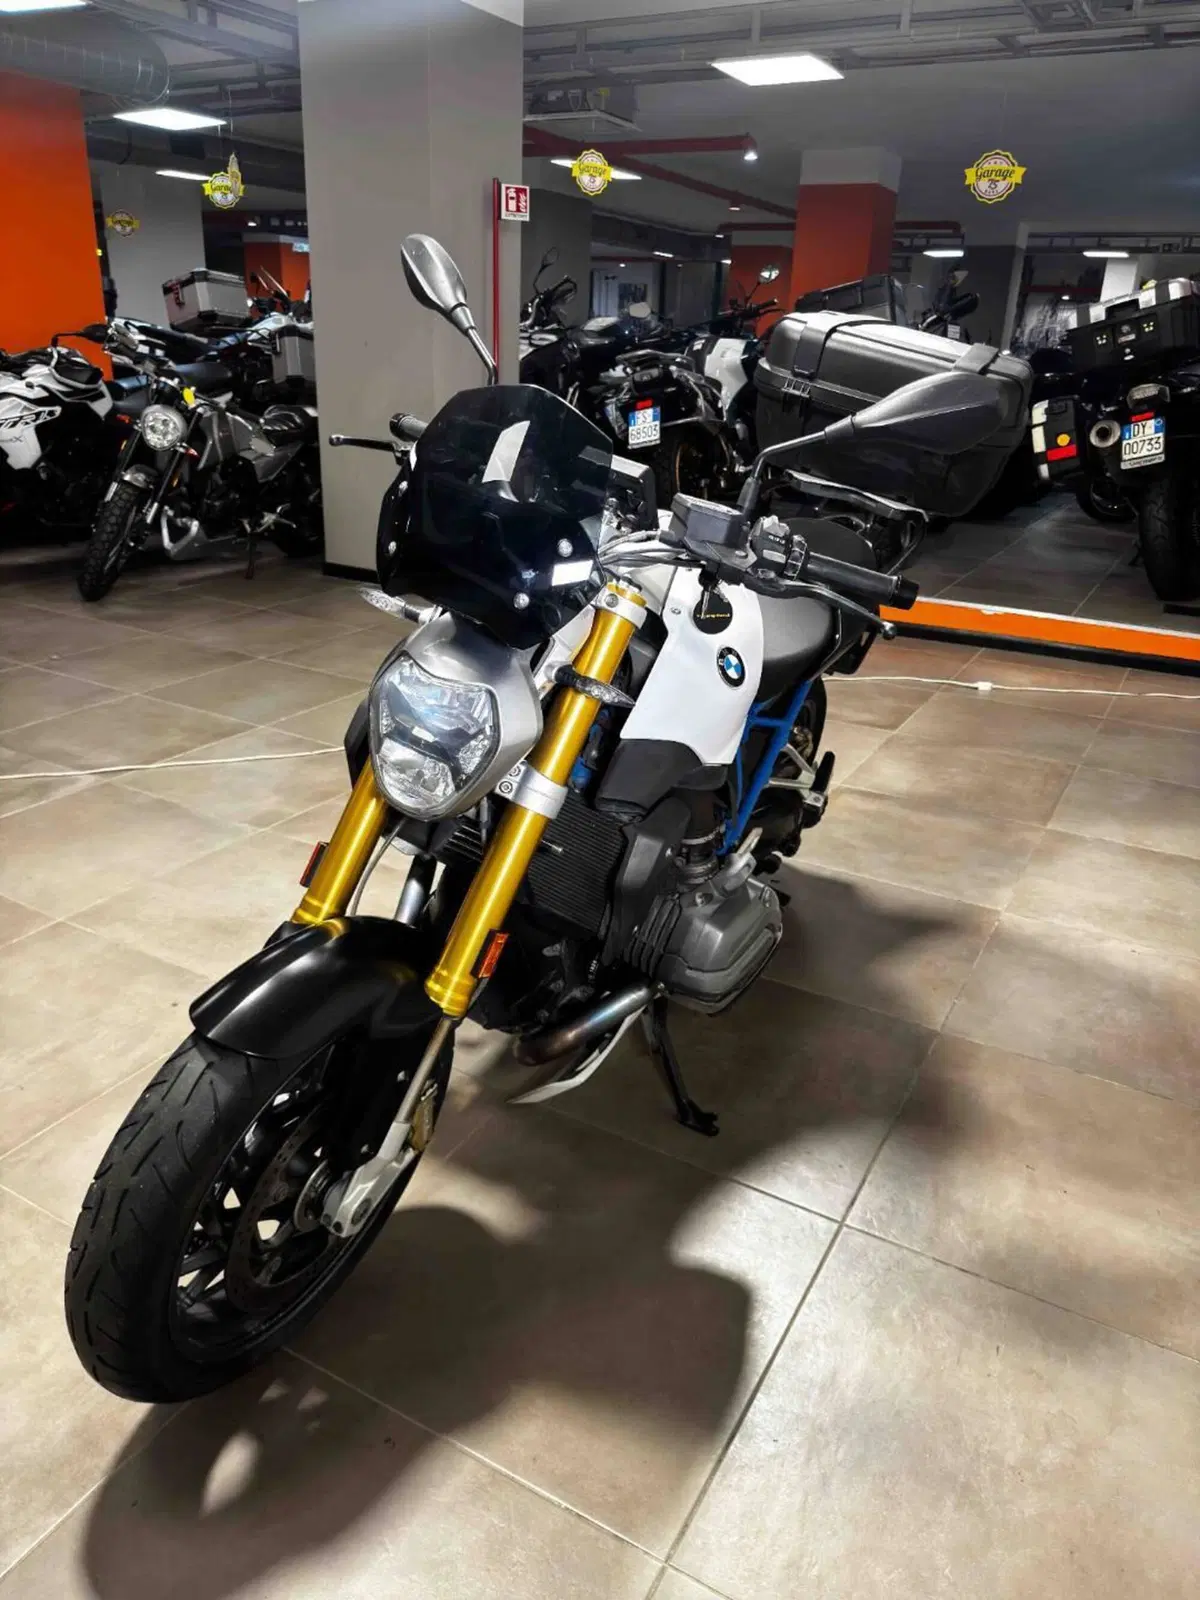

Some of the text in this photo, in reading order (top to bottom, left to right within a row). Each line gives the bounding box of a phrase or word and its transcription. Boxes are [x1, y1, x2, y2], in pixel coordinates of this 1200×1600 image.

[976, 167, 1015, 182] Garage
[630, 423, 659, 441] 68503
[1133, 421, 1147, 437] DY
[1123, 436, 1162, 456] 00733
